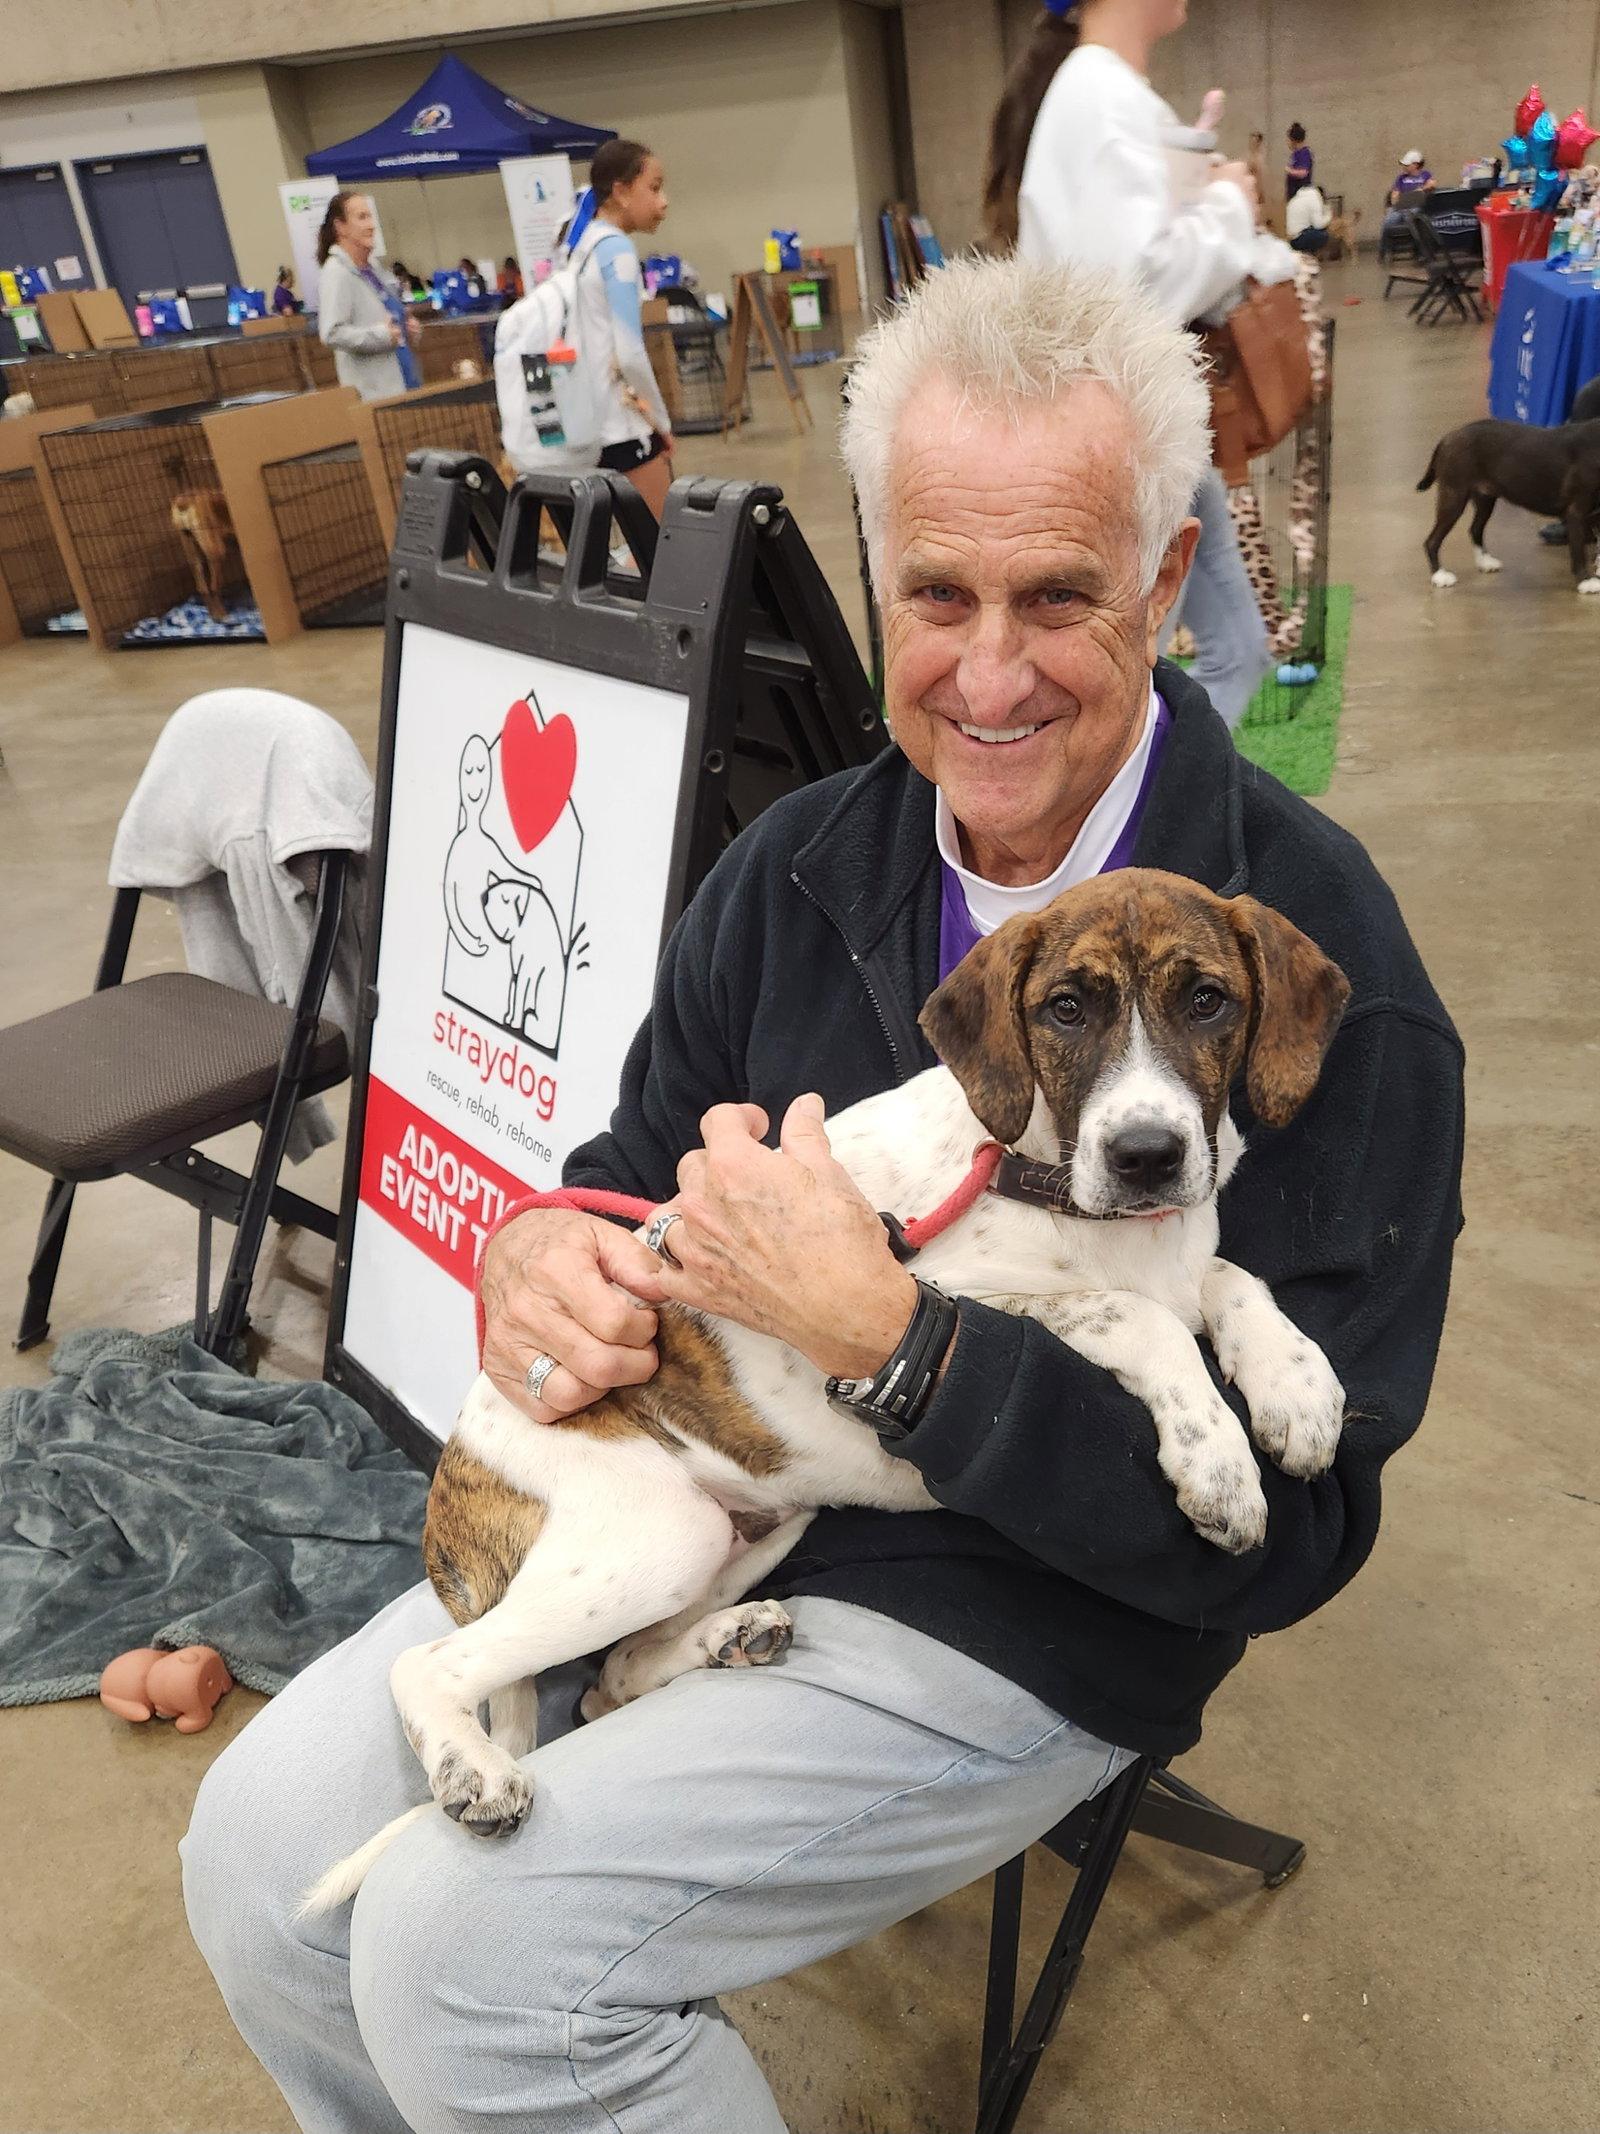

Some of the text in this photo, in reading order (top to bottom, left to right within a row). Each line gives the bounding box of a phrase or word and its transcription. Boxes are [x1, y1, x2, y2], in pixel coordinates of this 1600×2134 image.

[433, 1012, 557, 1121] straydog
[426, 1070, 552, 1163] rescue, rehab, rehome
[379, 1153, 466, 1252] EVENT
